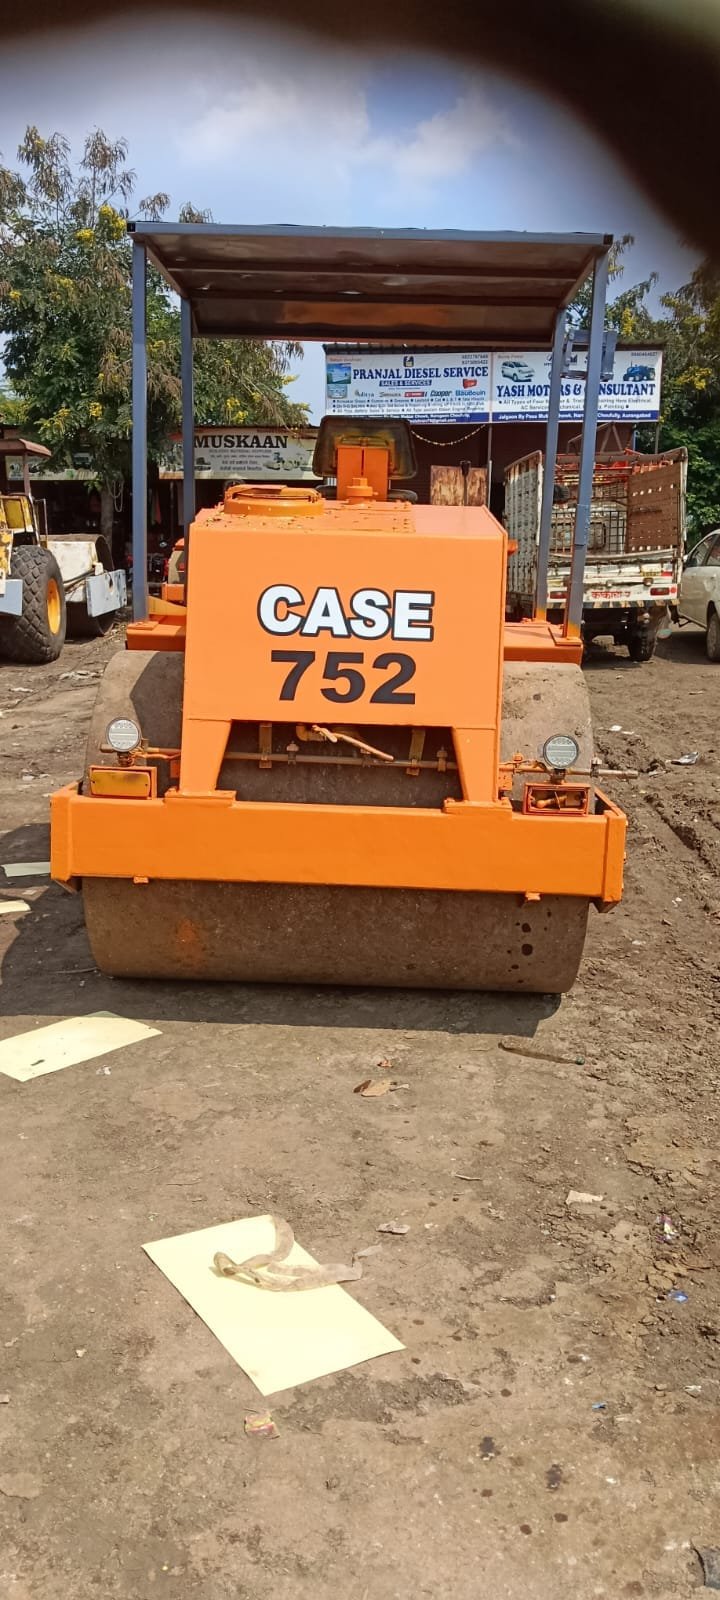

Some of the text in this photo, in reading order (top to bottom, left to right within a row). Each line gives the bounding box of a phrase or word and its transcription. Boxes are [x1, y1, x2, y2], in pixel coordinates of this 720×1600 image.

[353, 366, 488, 380] PRANJAL DIESEL SERVICE
[496, 384, 656, 398] YASH MOTRS & NSULTANT
[194, 434, 288, 448] MUSKAAN
[256, 584, 435, 642] CASE
[271, 650, 416, 705] 752
